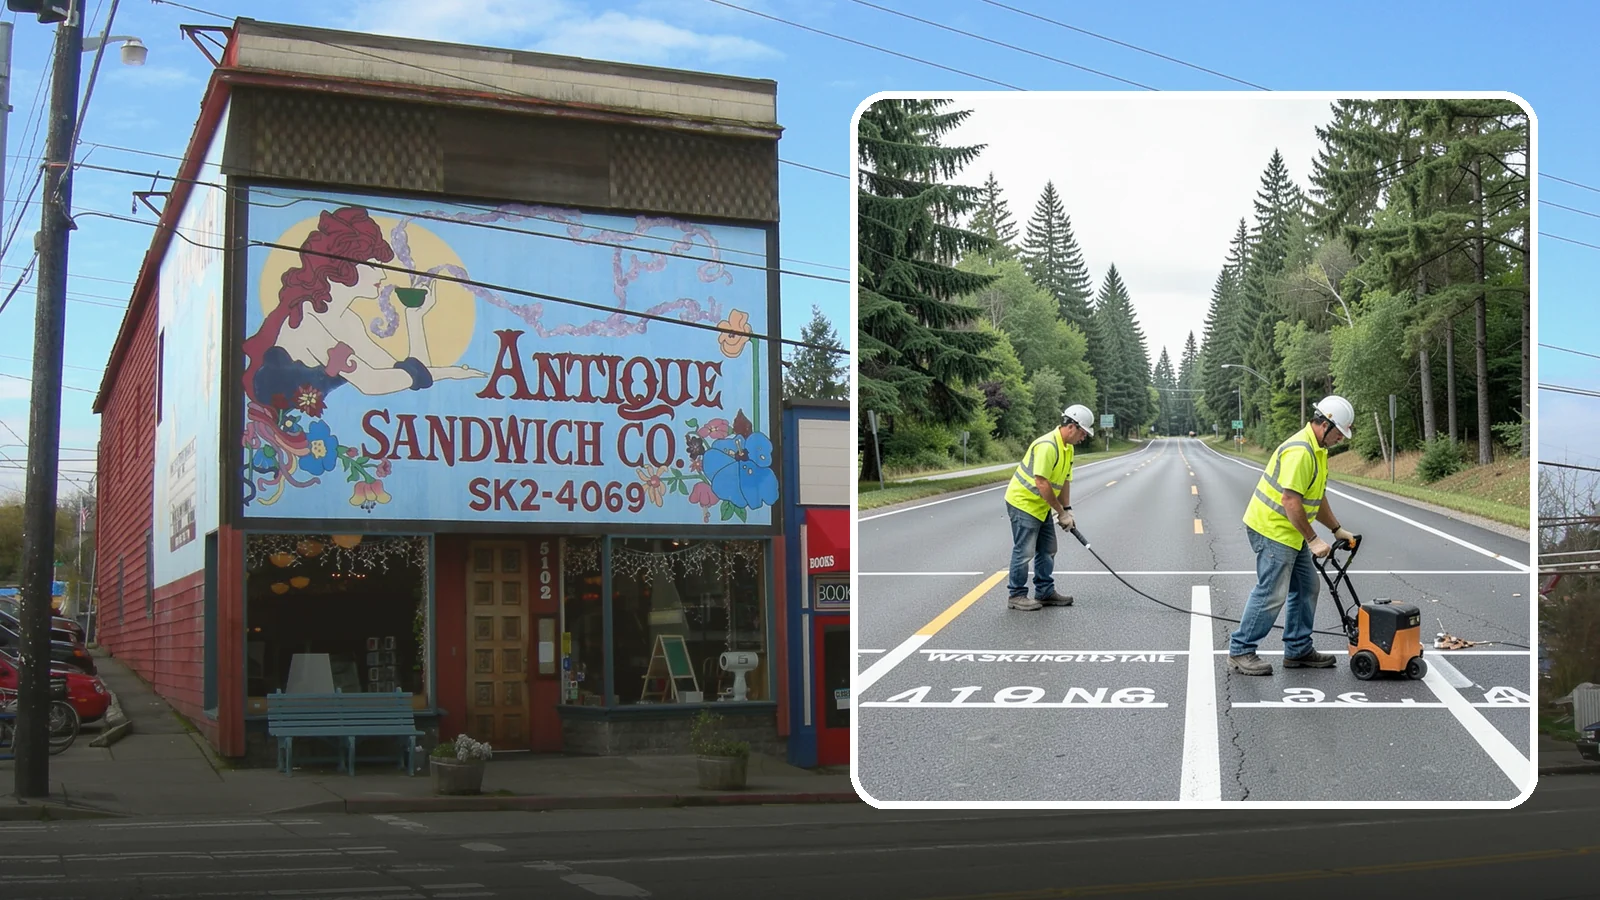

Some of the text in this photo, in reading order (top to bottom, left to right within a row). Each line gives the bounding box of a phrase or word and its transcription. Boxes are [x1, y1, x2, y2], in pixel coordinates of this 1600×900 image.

[476, 329, 723, 421] ANTIQUE
[362, 408, 685, 470] SANDWICH CO.
[468, 476, 646, 513] SK2-4069
[539, 541, 552, 600] 5102
[809, 555, 835, 569] BOOKS
